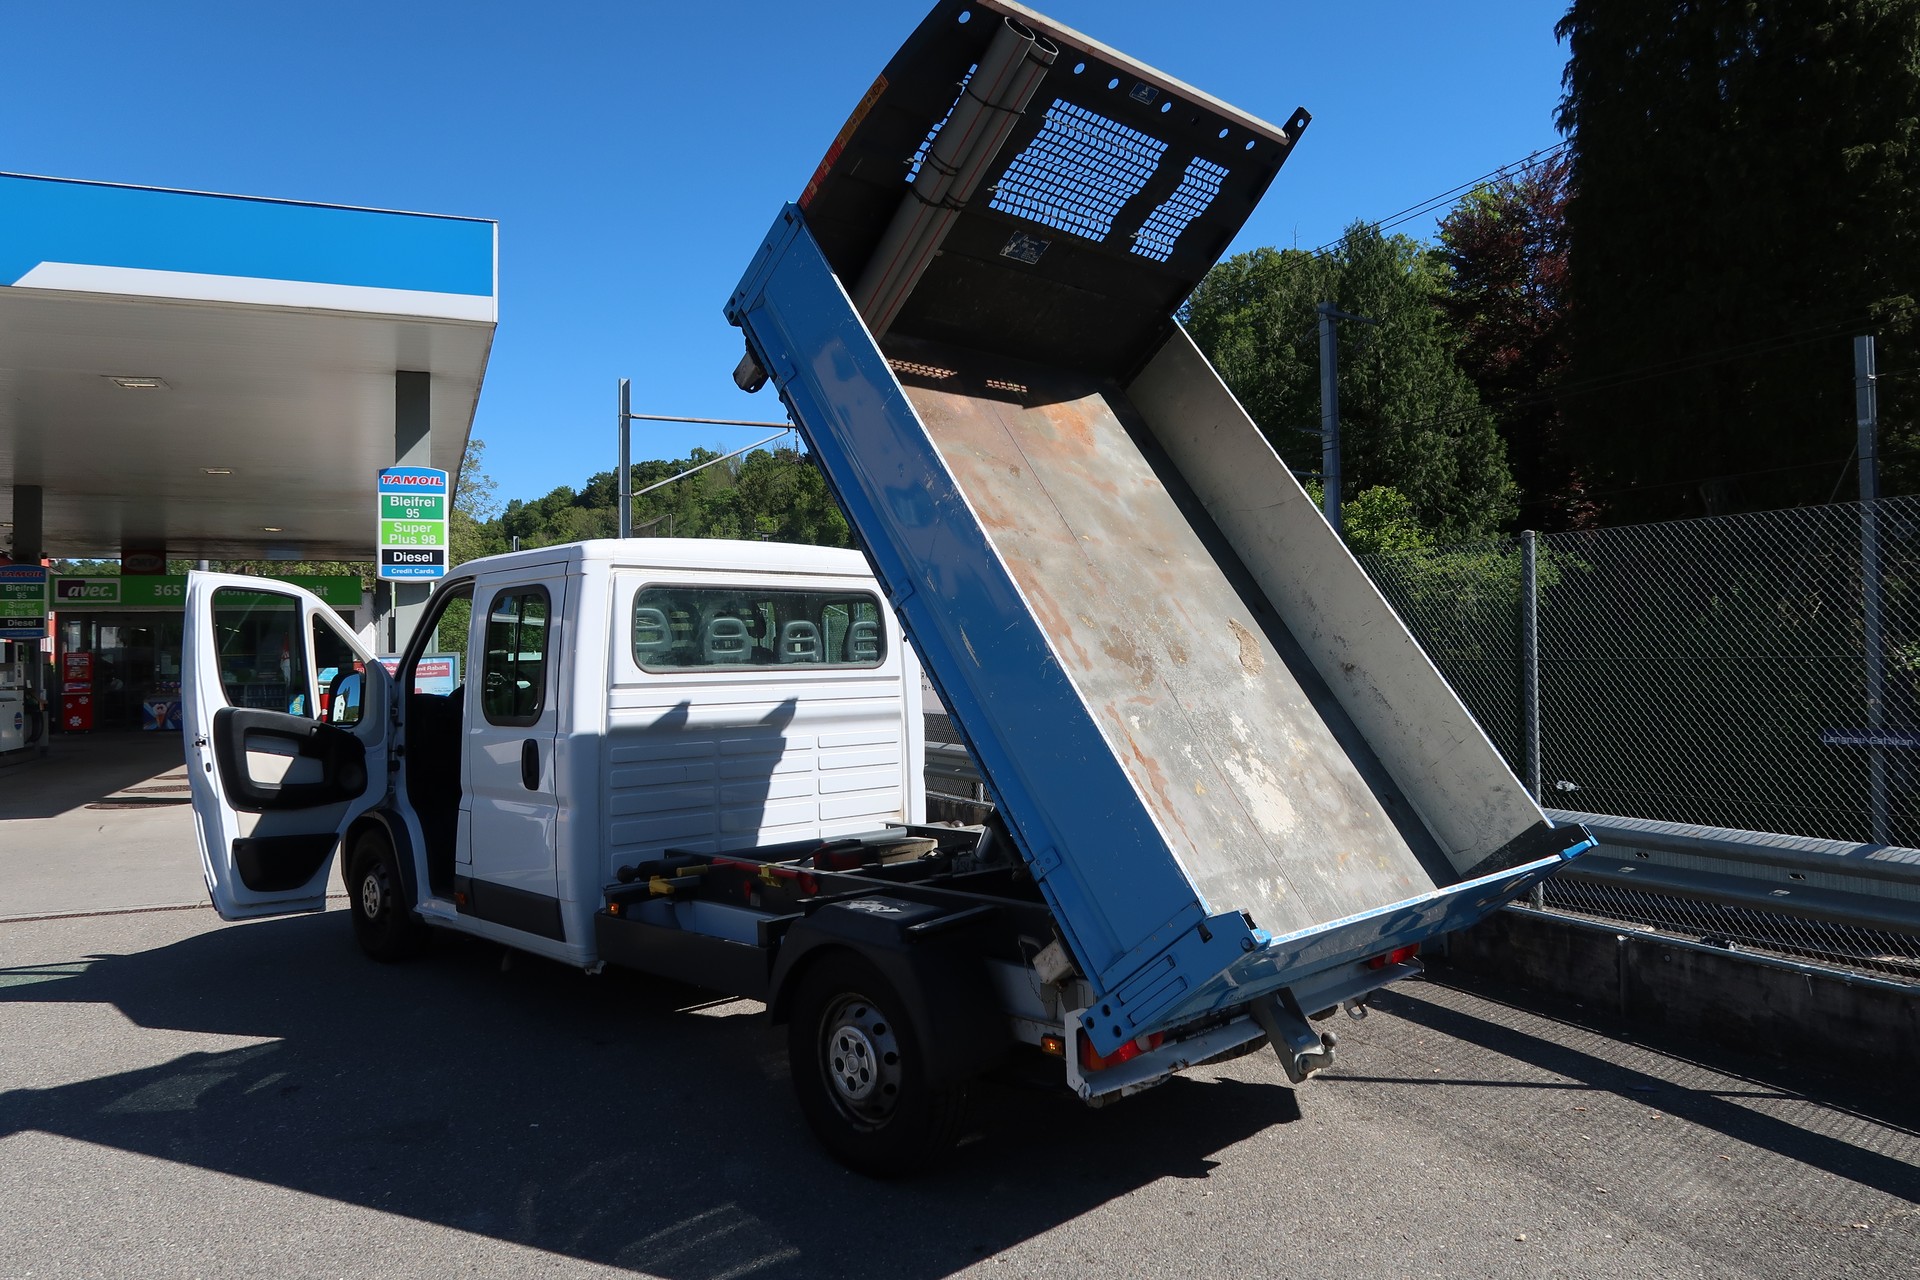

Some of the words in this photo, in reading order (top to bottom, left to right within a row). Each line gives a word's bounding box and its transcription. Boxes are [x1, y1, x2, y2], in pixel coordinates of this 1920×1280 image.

[382, 475, 444, 486] TAMOIL
[390, 496, 435, 507] Bleifrei
[406, 508, 420, 519] 95
[394, 522, 432, 535] Super
[389, 534, 418, 544] Plus
[421, 534, 437, 545] 98
[393, 552, 433, 563] Diesel
[5, 584, 38, 592] Bleifrei
[67, 586, 113, 597] avec.
[154, 584, 181, 597] 365
[7, 619, 37, 627] Diesel
